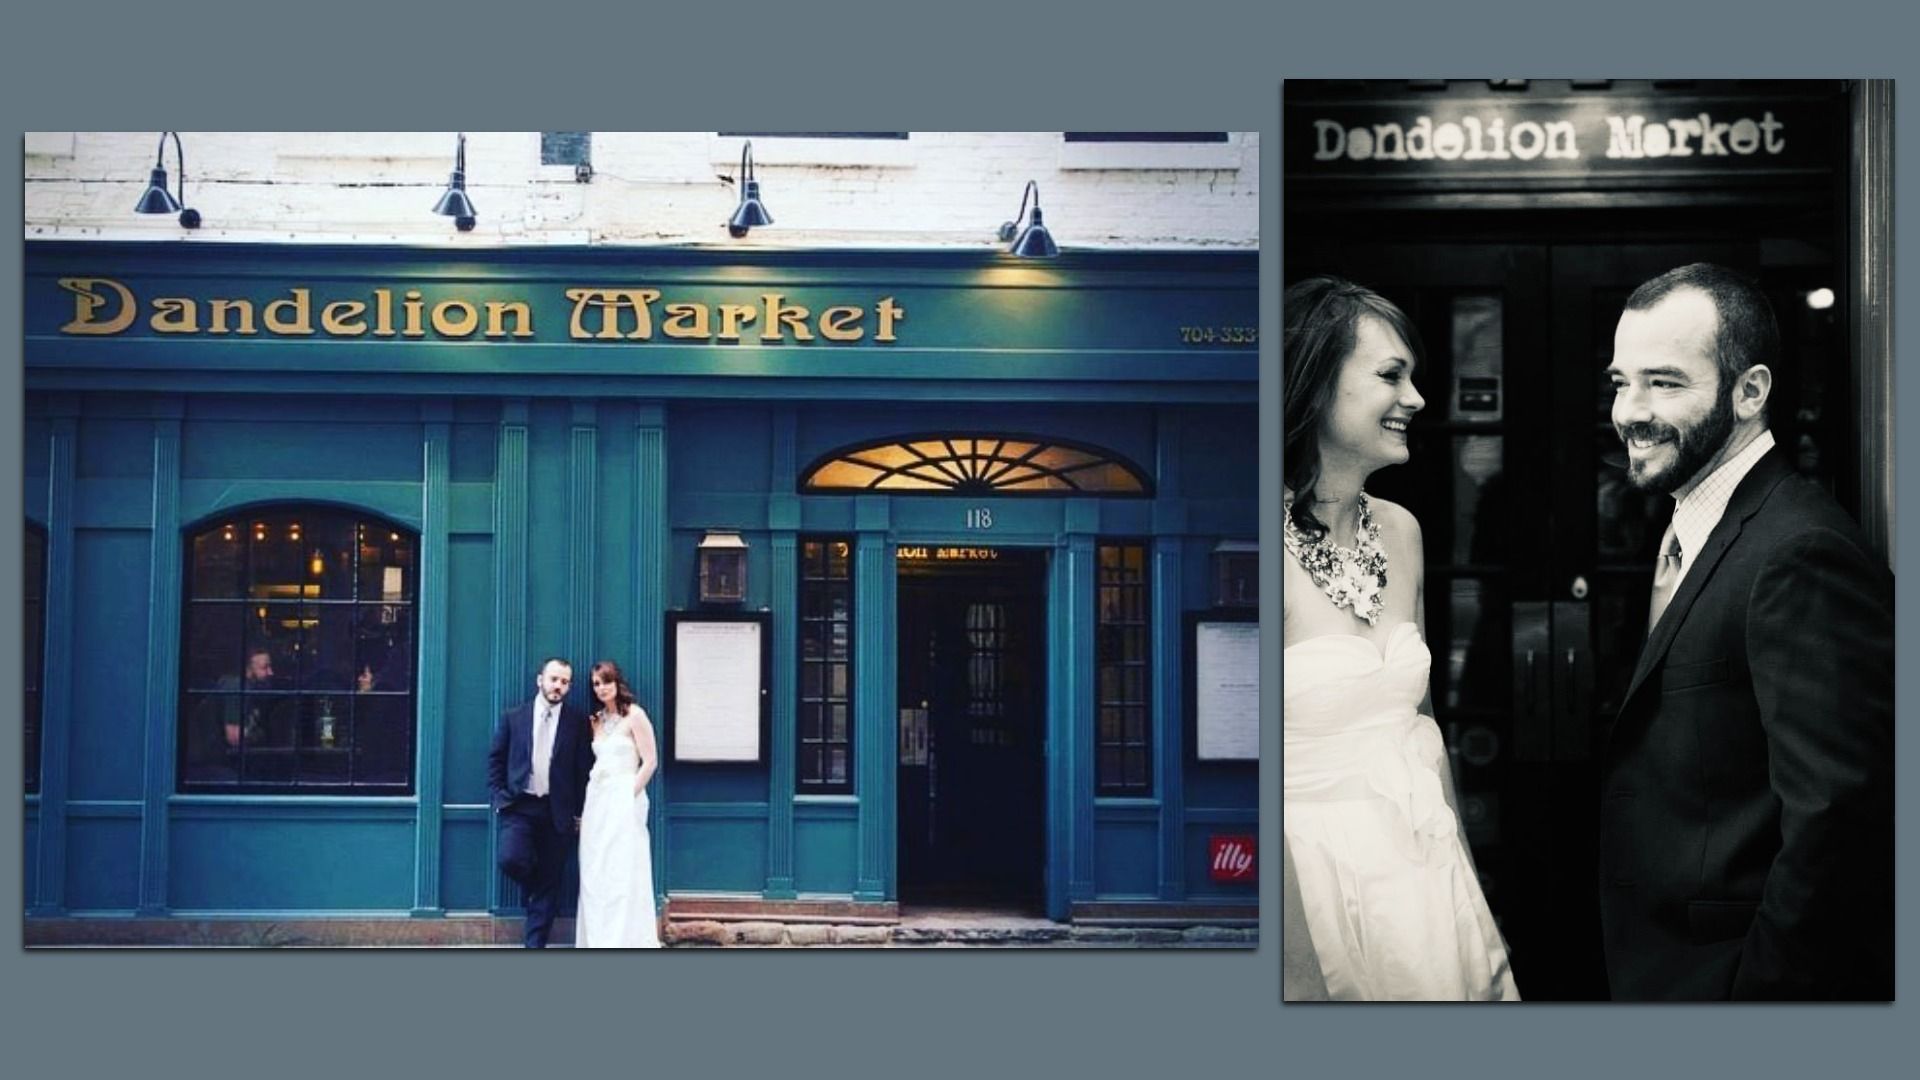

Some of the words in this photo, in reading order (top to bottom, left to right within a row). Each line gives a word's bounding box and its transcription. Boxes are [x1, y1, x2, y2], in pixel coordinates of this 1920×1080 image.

[1313, 116, 1580, 161] Dandelion
[1605, 111, 1786, 159] Market
[57, 276, 536, 338] Dandelion
[565, 288, 904, 342] Market
[967, 508, 992, 529] 118
[1213, 842, 1252, 877] illy
